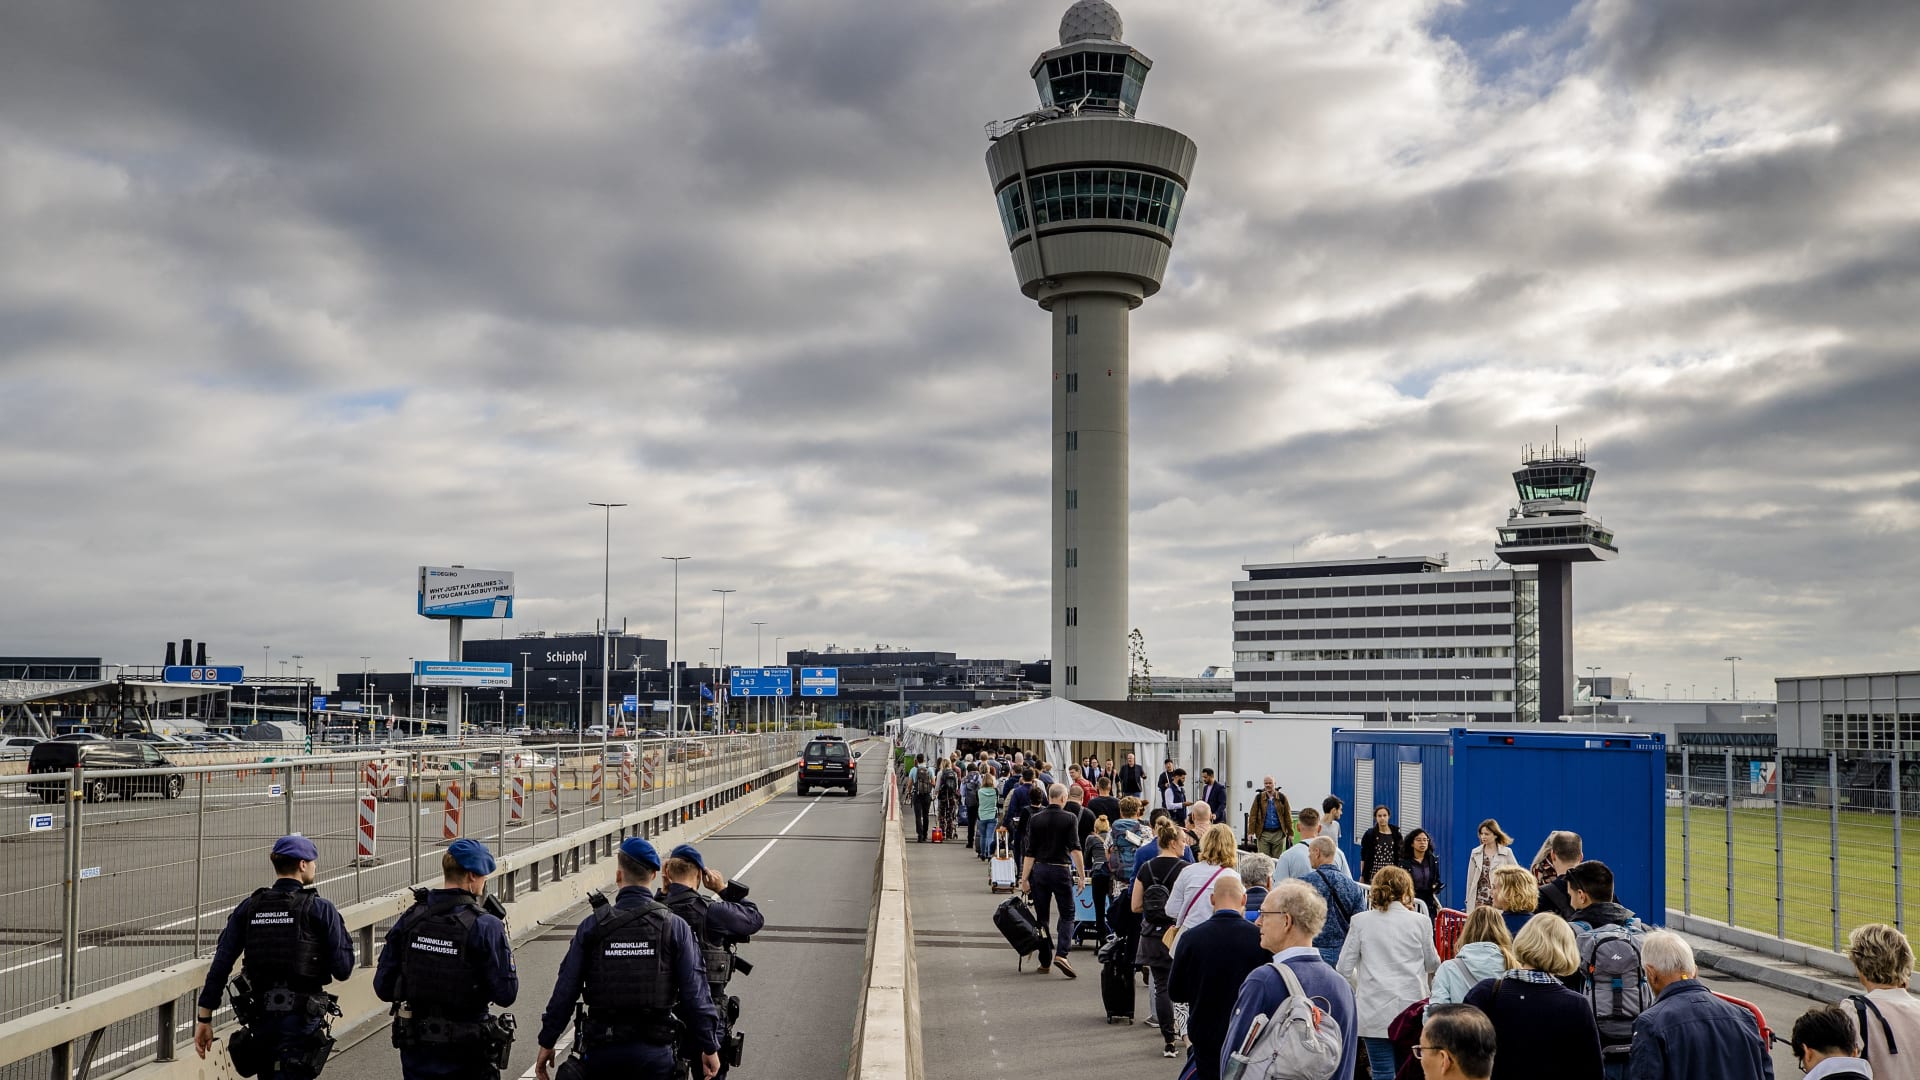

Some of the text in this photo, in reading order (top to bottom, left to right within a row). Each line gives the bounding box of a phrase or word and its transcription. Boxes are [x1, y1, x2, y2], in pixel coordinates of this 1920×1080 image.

[471, 580, 497, 588] AIRLINES
[546, 650, 587, 664] Schiphol
[431, 703, 436, 714] 2
[411, 942, 458, 955] MARECHAUSSEE
